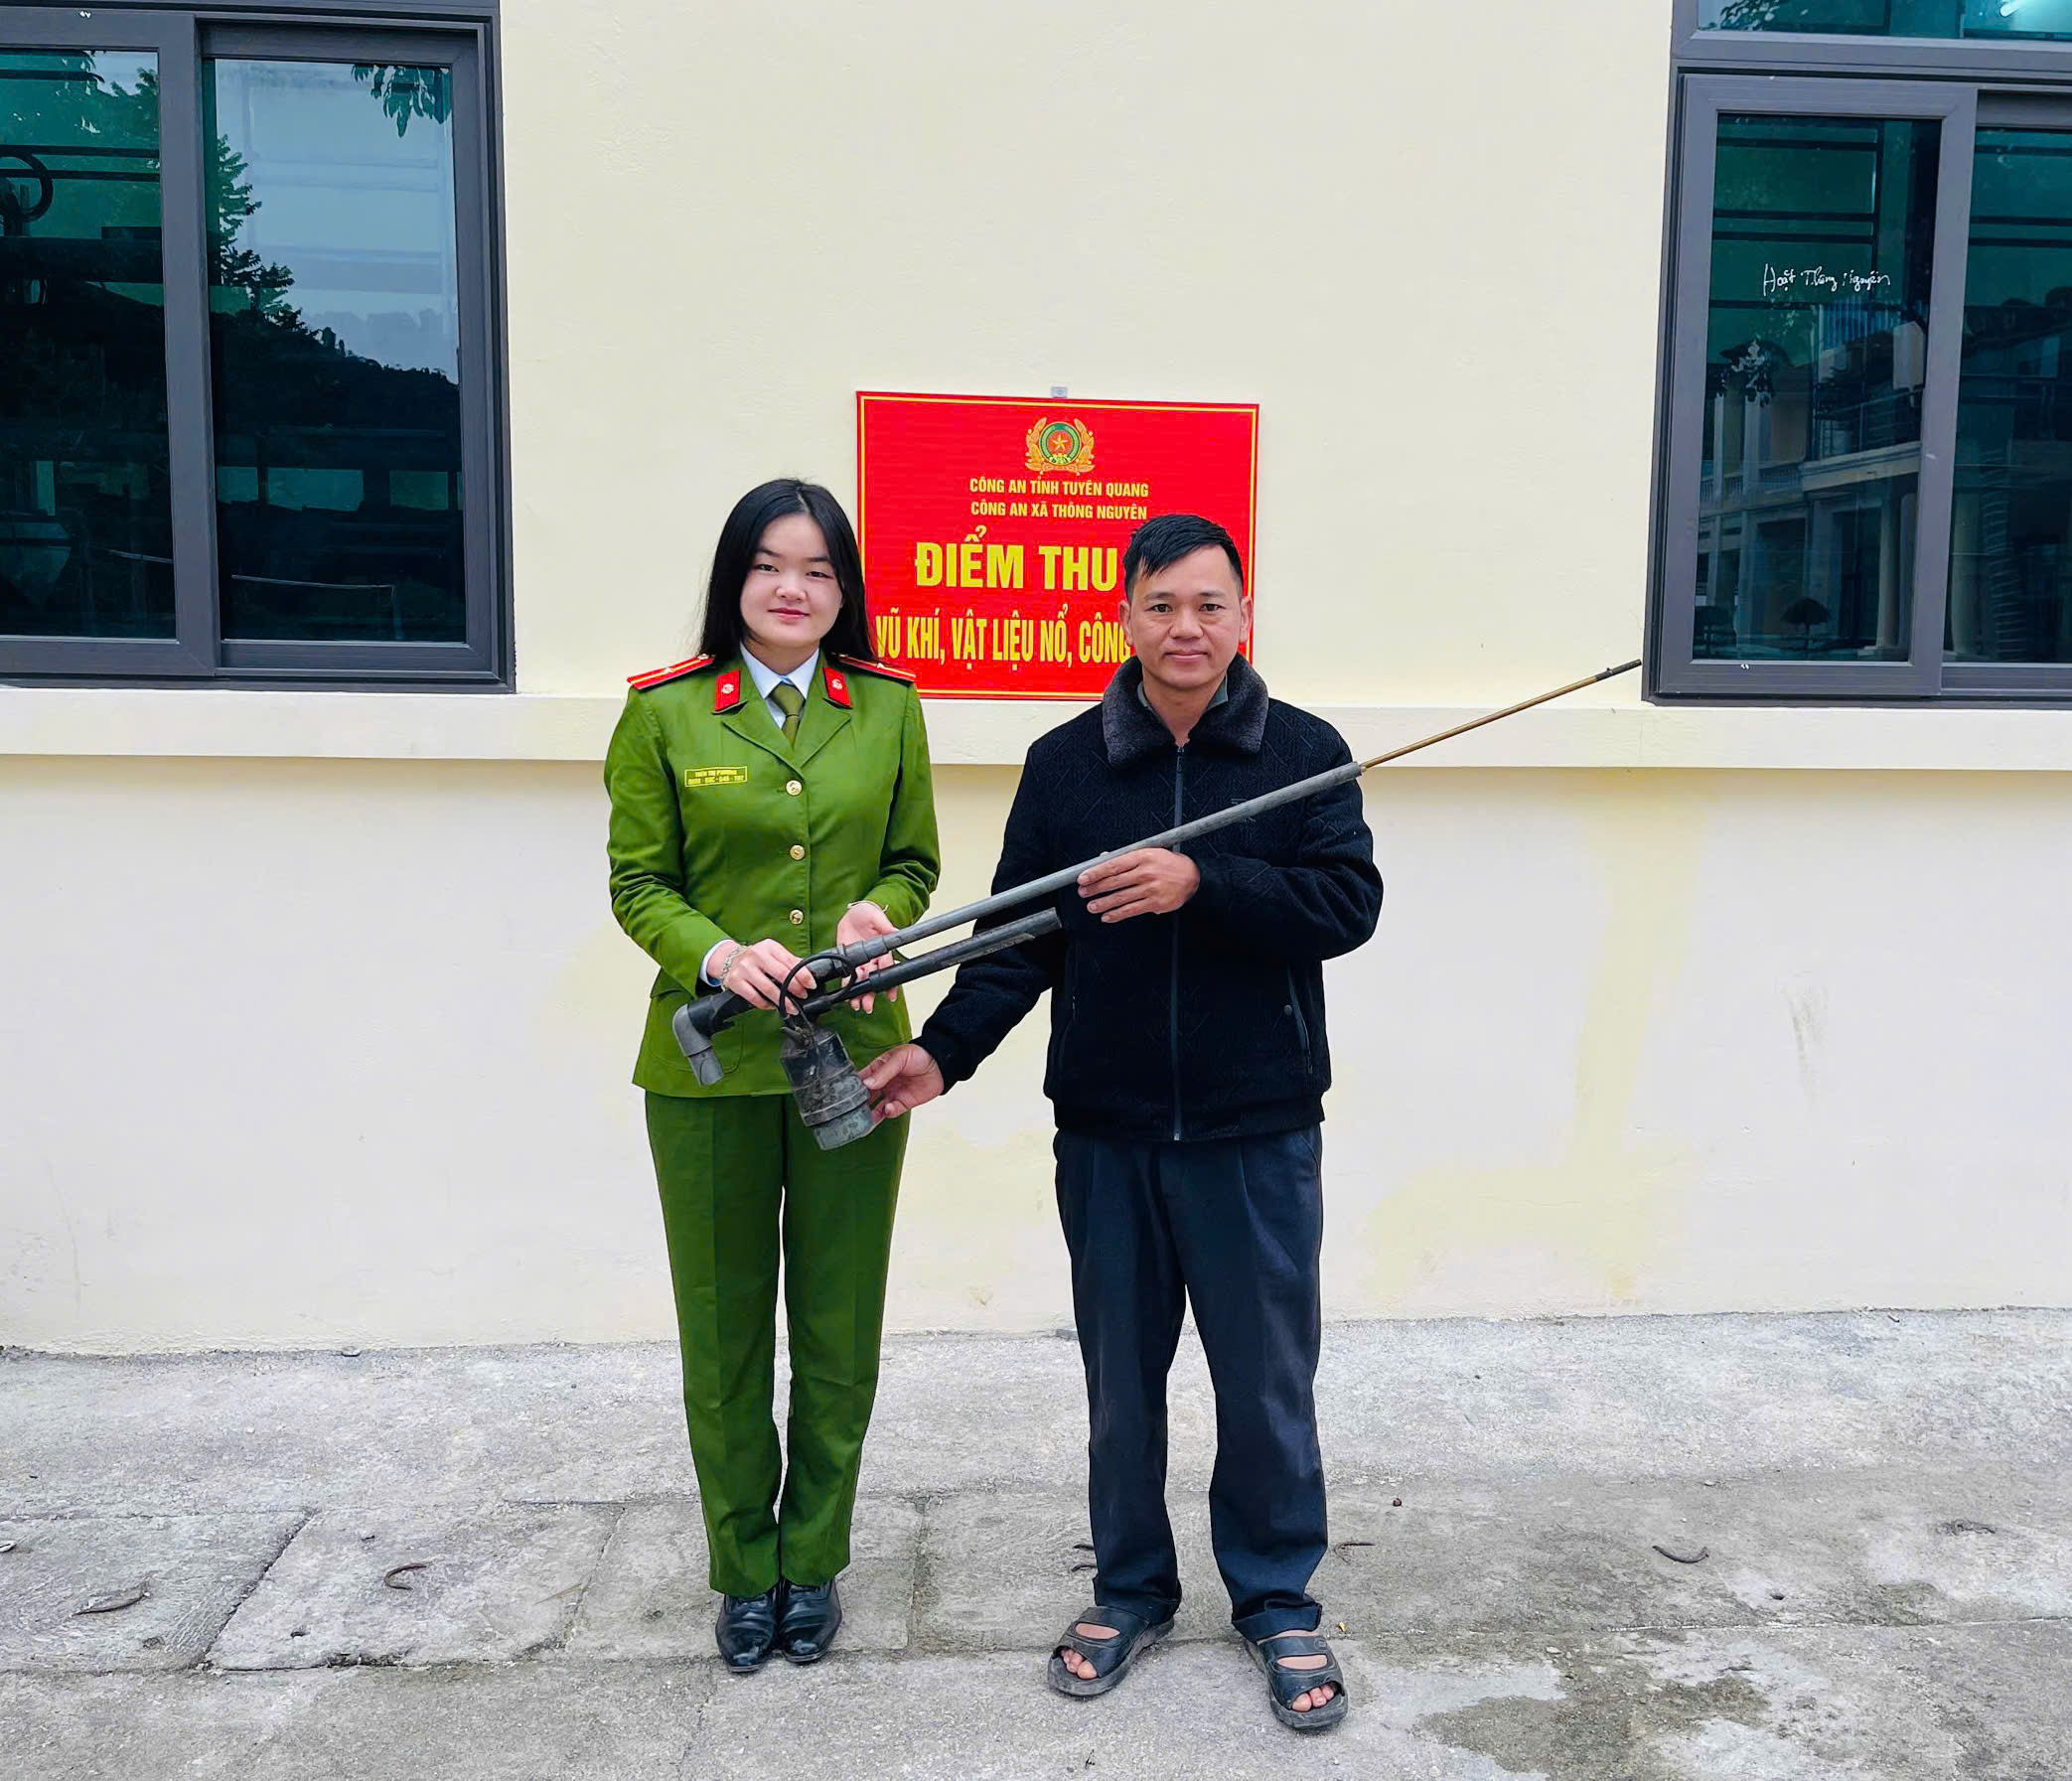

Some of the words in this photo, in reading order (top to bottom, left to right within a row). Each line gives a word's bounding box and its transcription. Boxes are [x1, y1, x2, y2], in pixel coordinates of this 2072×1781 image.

[969, 477, 1005, 494] CÔNG
[1008, 480, 1027, 494] AN
[1030, 476, 1059, 495] TỈNH
[1062, 480, 1103, 496] TUYÊN
[1106, 483, 1149, 498] QUANG
[970, 499, 1006, 517] CÔNG
[1009, 503, 1028, 517] AN
[1031, 501, 1049, 518] XÃ
[1052, 502, 1093, 519] THÔNG
[1097, 504, 1147, 519] NGUYÊN
[915, 524, 1024, 589] ĐIỂM
[1038, 545, 1118, 592] THU
[875, 607, 901, 660] VŨ
[907, 607, 946, 666] KHÍ,
[951, 608, 987, 669] VẬT
[992, 610, 1034, 671] LIỆU
[1040, 603, 1073, 668] NỔ,
